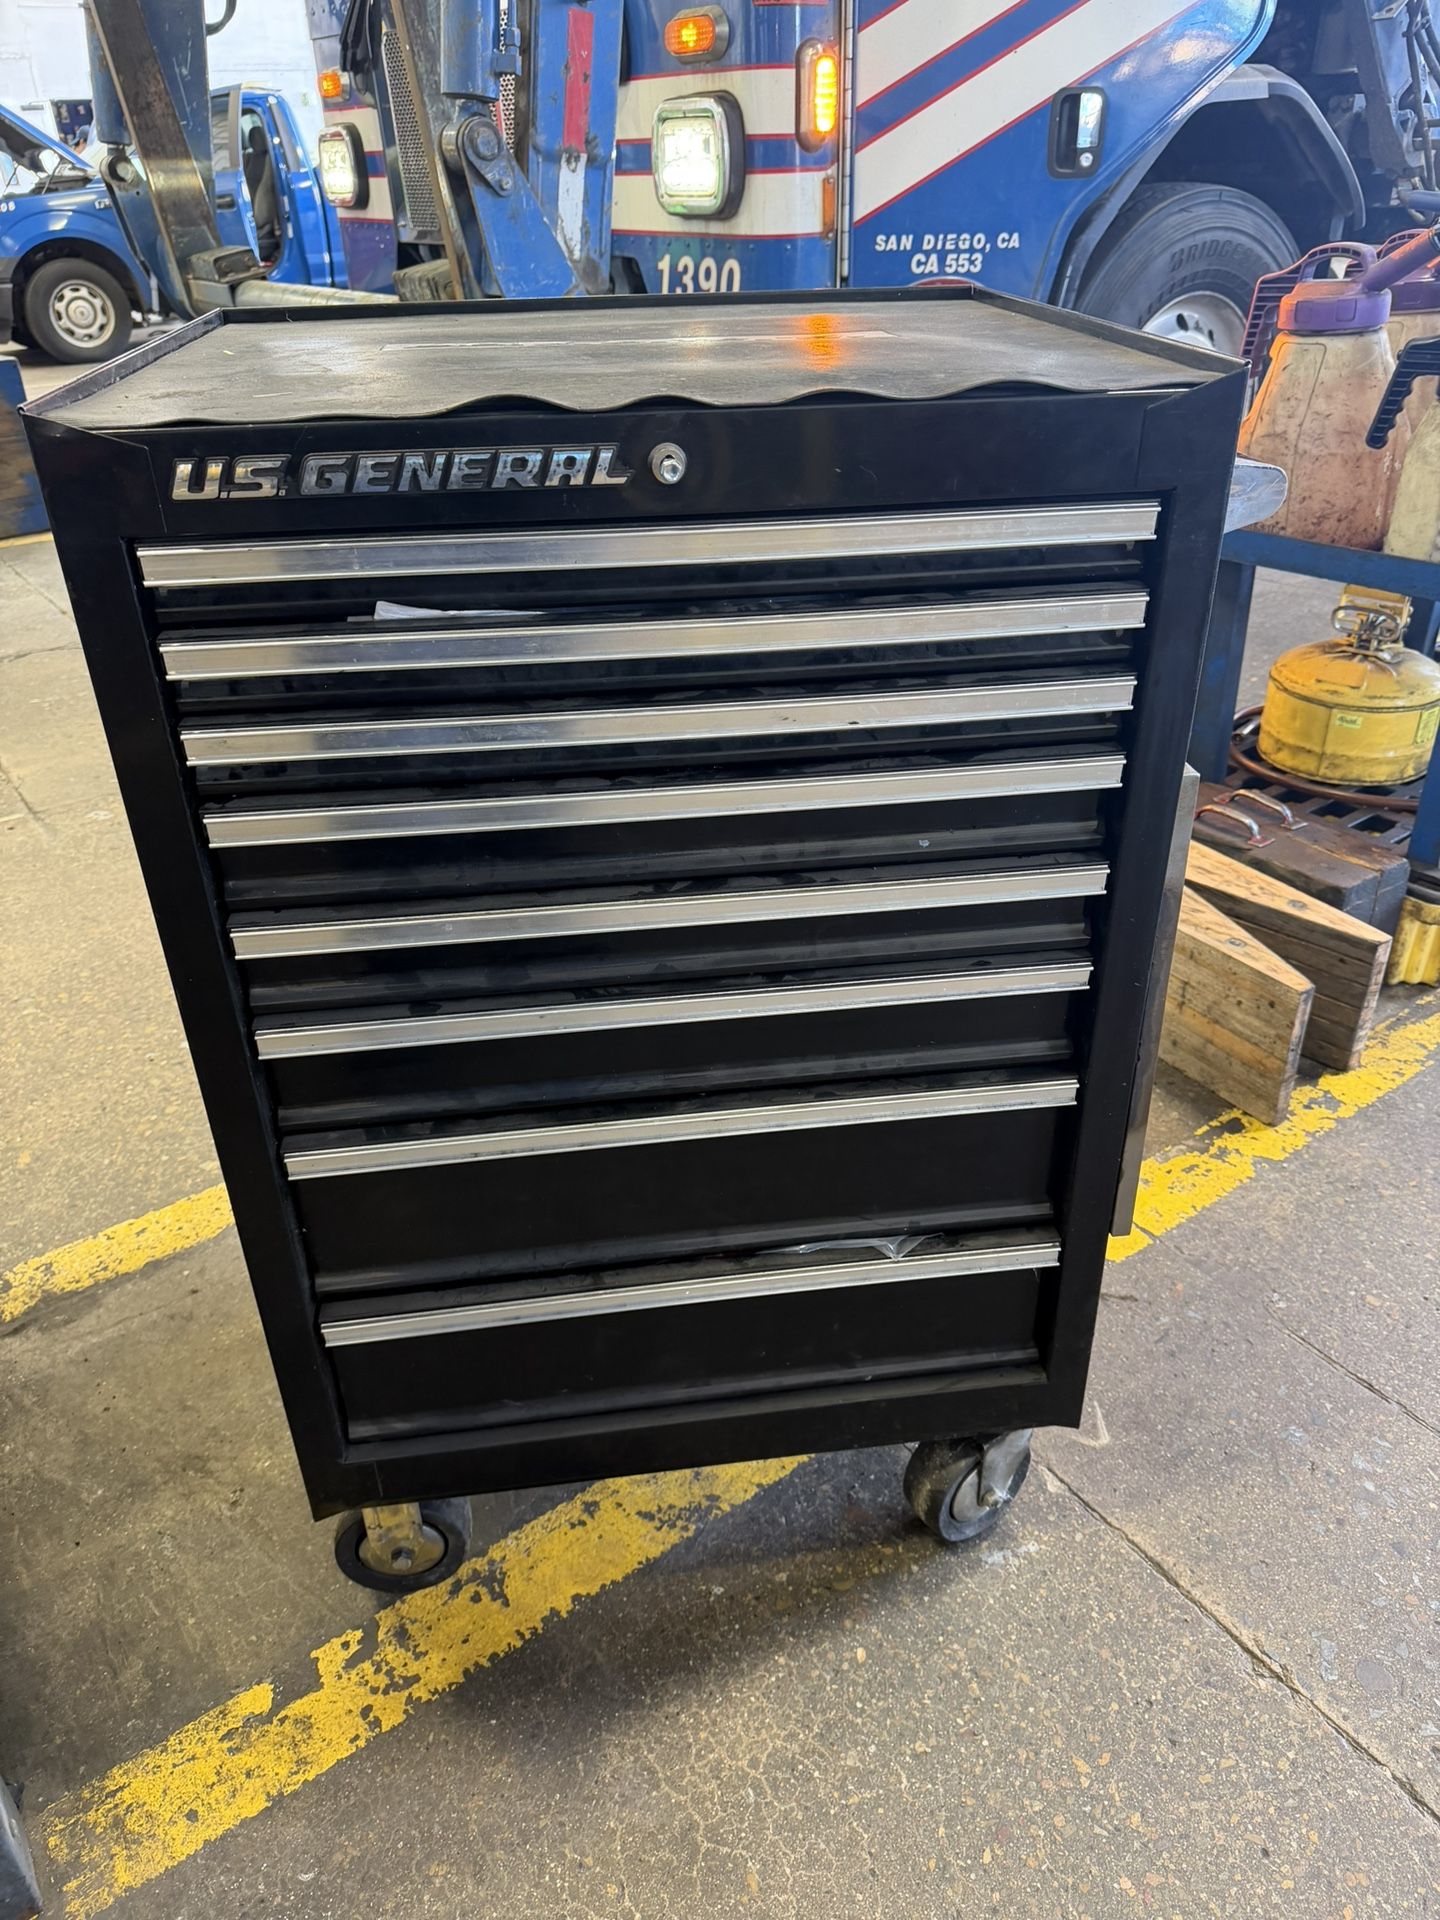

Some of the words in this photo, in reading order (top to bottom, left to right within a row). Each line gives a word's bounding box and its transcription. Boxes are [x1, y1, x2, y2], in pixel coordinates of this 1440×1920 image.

[875, 234, 914, 251] SAN
[922, 233, 991, 253] DIEGO,
[996, 232, 1020, 249] CA
[657, 253, 741, 295] 1390
[911, 253, 939, 274] CA
[944, 252, 983, 274] 553
[171, 455, 291, 501] U.S.
[300, 443, 636, 497] GENERAL
